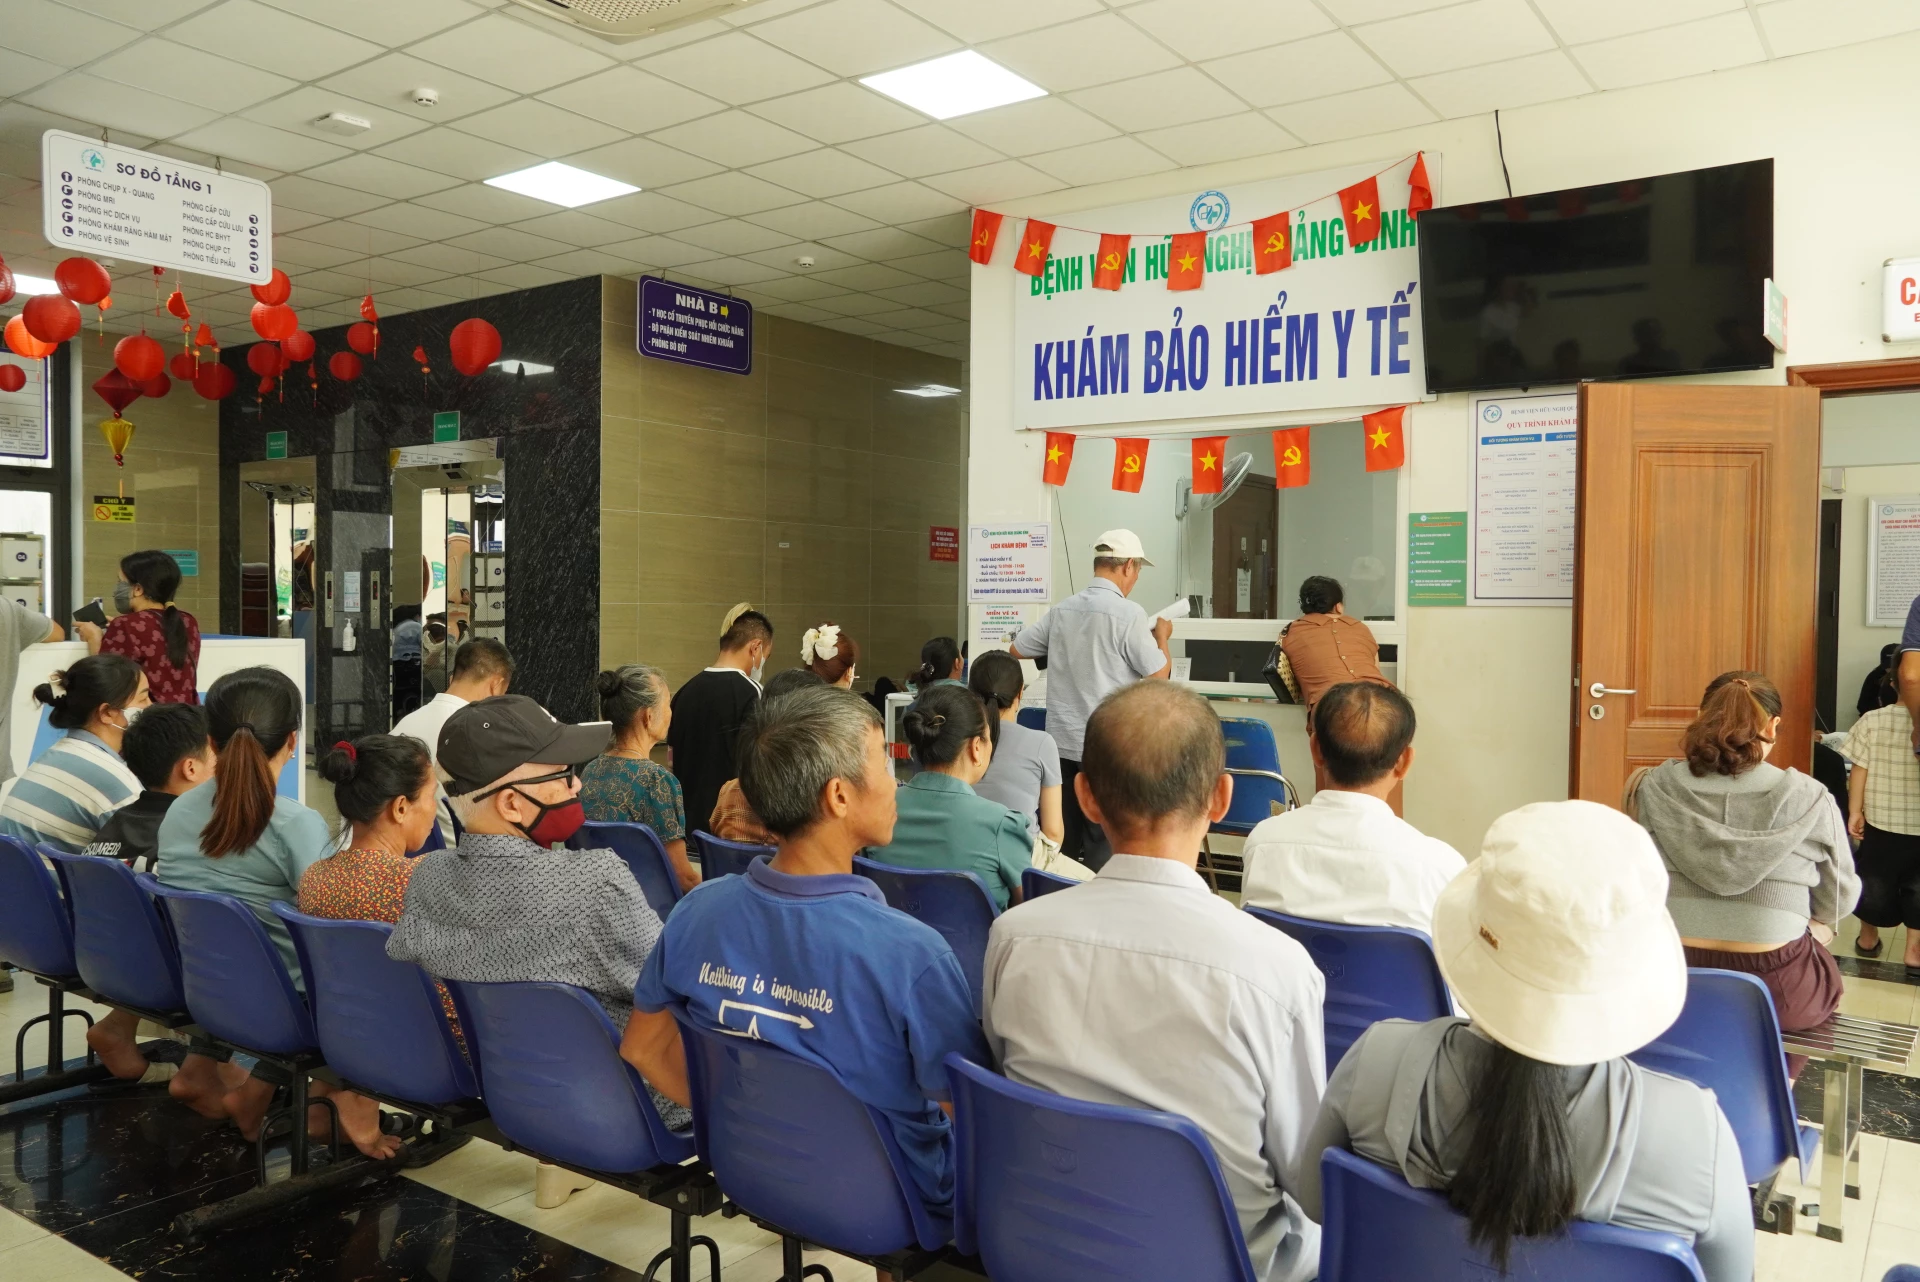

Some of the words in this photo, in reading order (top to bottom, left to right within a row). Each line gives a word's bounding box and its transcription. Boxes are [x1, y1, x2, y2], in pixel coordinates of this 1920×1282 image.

[78, 176, 101, 189] PHÒNG
[103, 182, 121, 193] CHỤP
[132, 189, 155, 200] QUANG
[117, 162, 136, 176] SƠ
[141, 166, 161, 182] ĐỒ
[165, 171, 202, 192] TẦNG
[206, 184, 212, 195] 1
[78, 190, 101, 202] PHÒNG
[103, 196, 115, 204] MRI
[78, 203, 102, 215] PHÒNG
[103, 209, 113, 217] HC
[114, 211, 130, 221] DỊCH
[132, 215, 141, 224] VỤ
[182, 200, 203, 211] PHÒNG
[205, 204, 217, 214] CẤP
[218, 208, 231, 217] CỨU
[78, 217, 102, 229] PHÒNG
[103, 222, 122, 233] KHÁM
[144, 230, 158, 240] HÀM
[182, 213, 204, 224] PHÒNG
[205, 217, 217, 226] CẤP
[218, 220, 231, 230] CỨU
[231, 224, 244, 233] LƯU
[78, 230, 102, 242] PHÒNG
[104, 235, 112, 245] VỆ
[114, 237, 130, 247] SINH
[183, 226, 204, 237] PHÒNG
[205, 230, 214, 239] HC
[215, 233, 231, 241] BHYT
[183, 238, 204, 249] PHÒNG
[205, 243, 222, 253] CHỤP
[183, 251, 204, 262] PHÒNG
[675, 293, 706, 312] NHÀ
[709, 302, 718, 314] B
[652, 308, 656, 317] Y
[656, 310, 667, 320] HỌC
[675, 313, 695, 326] TRUYỀN
[695, 318, 708, 329] PHỤC
[709, 319, 717, 331] HỒI
[717, 323, 730, 333] CHỨC
[731, 325, 745, 337] NĂNG
[651, 322, 659, 334] BỘ
[660, 325, 674, 336] PHẬN
[674, 326, 688, 339] KIỂM
[688, 330, 701, 341] SOÁT
[701, 332, 717, 345] NHIỄM
[717, 336, 734, 349] KHUẨN
[651, 337, 669, 349] PHÒNG
[1034, 325, 1130, 401] KHÁM
[1143, 306, 1210, 394] BẢO
[1224, 290, 1319, 387] HIỂM
[1332, 309, 1356, 379] Y
[1366, 282, 1418, 376] TẾ
[1507, 422, 1523, 430] QUY
[1524, 418, 1546, 428] TRÌNH
[1548, 417, 1571, 426] KHÁM
[1015, 541, 1028, 549] BỆNH
[752, 973, 765, 994] is
[771, 977, 834, 1014] impossible
